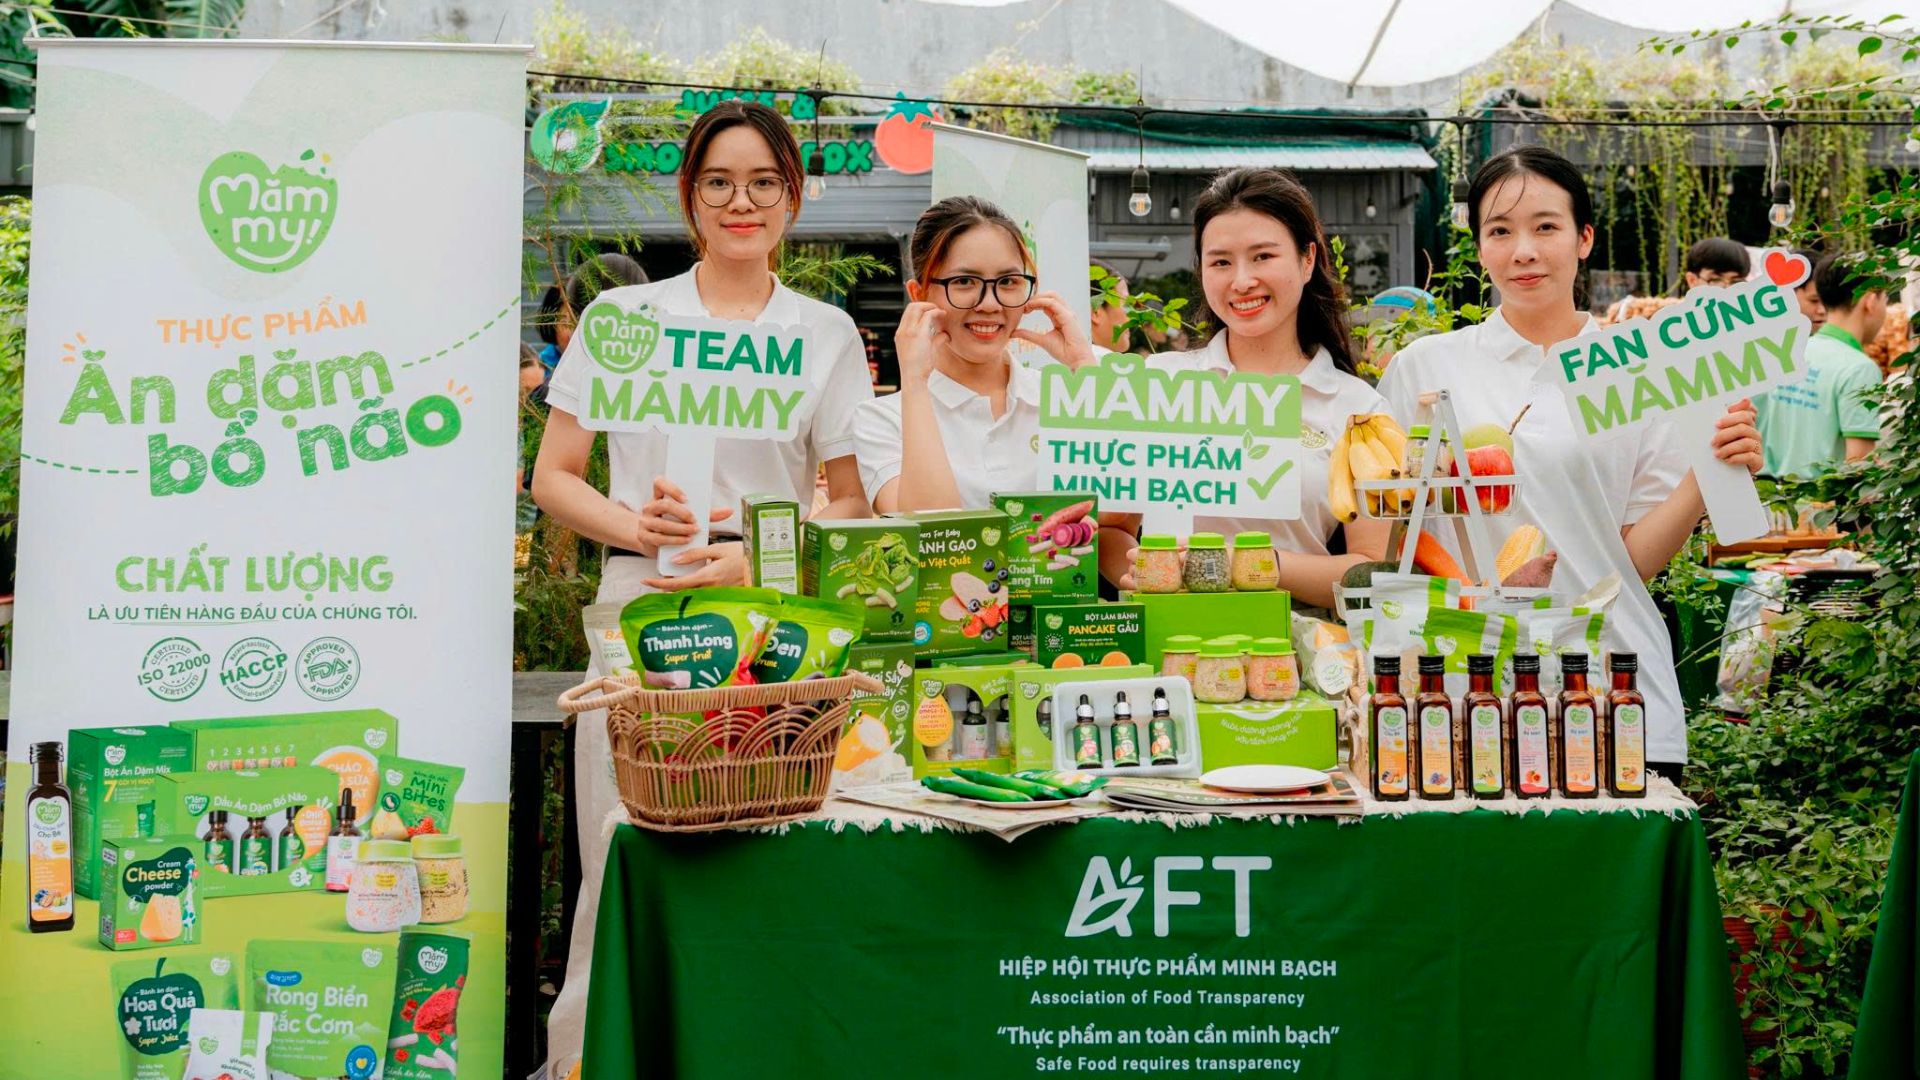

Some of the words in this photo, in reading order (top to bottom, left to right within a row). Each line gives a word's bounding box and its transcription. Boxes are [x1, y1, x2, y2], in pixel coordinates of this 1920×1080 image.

[210, 173, 328, 214] Măm
[232, 218, 322, 265] my!
[157, 313, 252, 348] THỰC
[264, 296, 367, 338] PHẨM
[590, 316, 654, 341] Măm
[1559, 328, 1649, 383] FAN
[1659, 284, 1788, 350] CỨNG
[601, 341, 650, 368] my!
[664, 328, 803, 376] TEAM
[59, 349, 176, 425] Ăn
[206, 347, 394, 429] dặm
[1575, 326, 1799, 436] MĂMMY
[589, 369, 805, 430] MĂMMY
[1049, 361, 1290, 427] MĂMMY
[148, 409, 266, 497] bổ
[296, 394, 462, 477] não
[1048, 438, 1136, 472] THỰC
[1147, 437, 1242, 471] PHẨM
[1053, 474, 1136, 501] MINH
[1149, 478, 1236, 509] BẠCH
[919, 540, 945, 554] ÁNH
[949, 538, 977, 554] GẠO
[115, 543, 229, 593] CHẤT
[246, 552, 394, 602] LƯỢNG
[929, 558, 946, 569] Việt
[950, 555, 972, 567] Quất
[1008, 577, 1031, 588] ang
[88, 603, 110, 620] LÀ
[115, 604, 139, 620] ƯU
[144, 602, 179, 620] TIÊN
[187, 602, 235, 620] HÀNG
[240, 601, 277, 620] ĐẦU
[282, 602, 317, 620] CỦA
[322, 602, 382, 620] CHÚNG
[387, 603, 417, 620] TÔI.
[1068, 624, 1115, 635] PANCAKE
[303, 642, 345, 664] APPROVED
[644, 634, 692, 653] Thanh
[695, 633, 733, 650] Long
[138, 668, 164, 686] ISO
[168, 653, 211, 677] 22000
[219, 653, 288, 687] HACCP
[307, 657, 349, 683] FDA
[664, 654, 689, 665] Super
[693, 650, 713, 662] Fruit
[310, 674, 353, 695] APPROVED
[155, 765, 171, 774] Mix
[104, 779, 117, 802] 7
[410, 776, 446, 795] Mini
[402, 787, 446, 812] Bites
[126, 867, 181, 882] Cheese
[144, 882, 173, 892] powder
[1064, 855, 1272, 938] AFT
[1000, 955, 1047, 980] HIỆP
[1052, 955, 1088, 980] HỘI
[1093, 957, 1151, 980] THỰC
[1157, 953, 1216, 976] PHẨM
[1222, 958, 1276, 976] MINH
[1281, 960, 1337, 980] BẠCH
[124, 997, 157, 1013] Hoa
[161, 990, 196, 1012] Quả
[266, 985, 318, 1012] Rong
[324, 985, 368, 1007] Biển
[1031, 990, 1126, 1005] Association
[1131, 990, 1147, 1005] of
[1153, 990, 1192, 1005] Food
[1197, 990, 1305, 1008] Transparency
[143, 1014, 177, 1031] Tươi
[305, 1013, 353, 1034] Cơm
[997, 1026, 1054, 1047] “Thực
[1058, 1023, 1111, 1048] phẩm
[1117, 1030, 1141, 1044] an
[1145, 1026, 1189, 1045] toàn
[1194, 1023, 1226, 1044] cần
[1232, 1026, 1279, 1044] minh
[1285, 1026, 1340, 1048] bạch”
[1036, 1056, 1072, 1071] Safe
[1078, 1056, 1117, 1071] Food
[1122, 1056, 1190, 1074] requires
[1195, 1057, 1301, 1074] transparency
